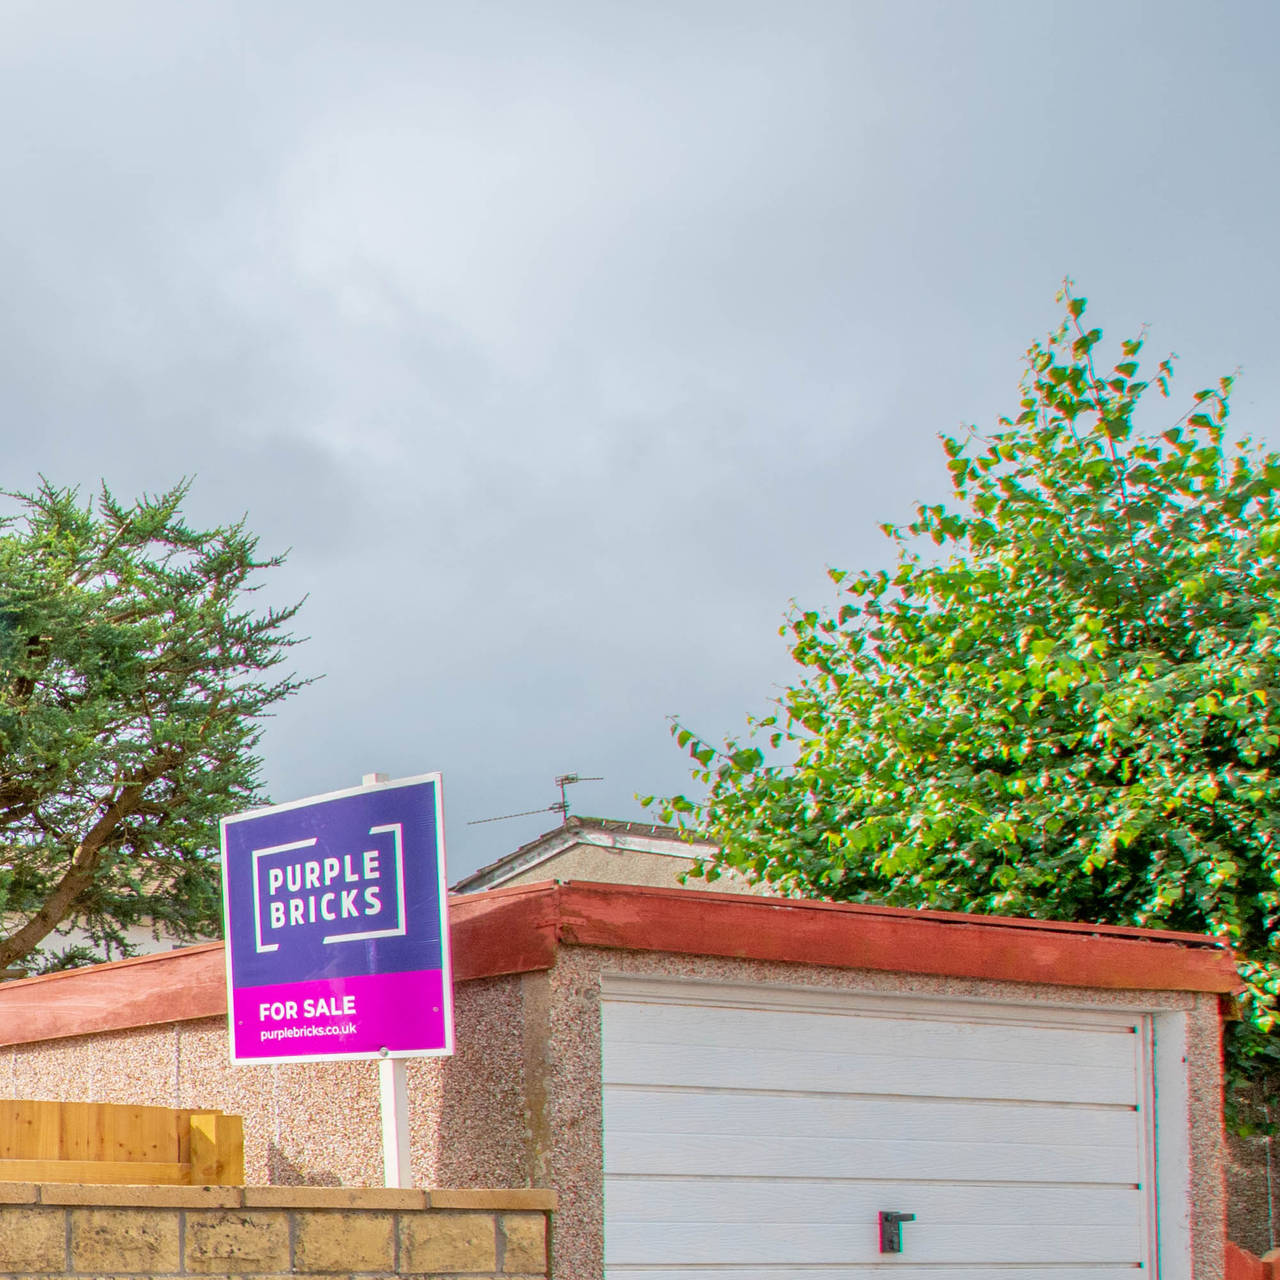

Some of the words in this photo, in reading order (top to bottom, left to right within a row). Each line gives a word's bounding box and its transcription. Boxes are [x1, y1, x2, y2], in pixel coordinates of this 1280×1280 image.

[269, 850, 381, 896] PURPLE
[270, 886, 383, 929] BRICKS
[259, 1000, 298, 1021] FOR
[303, 995, 357, 1019] SALE
[260, 1022, 358, 1042] purplebricks.co.uk
